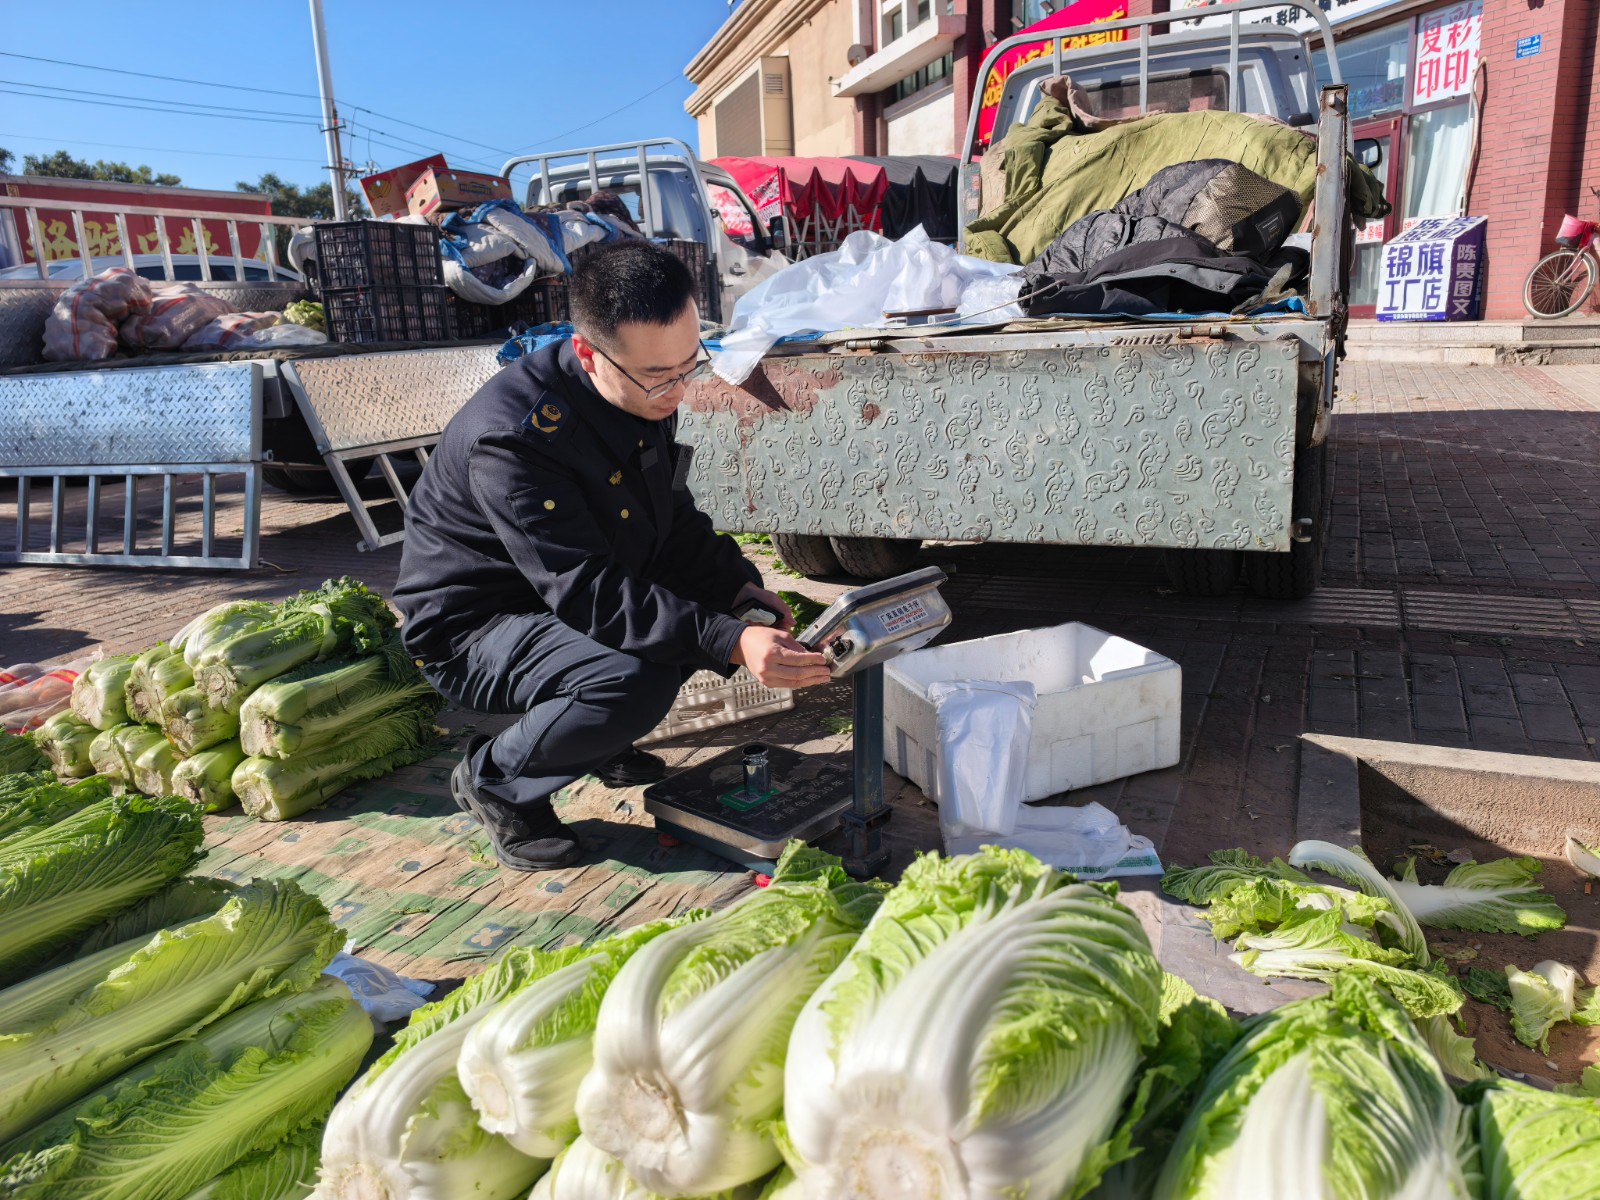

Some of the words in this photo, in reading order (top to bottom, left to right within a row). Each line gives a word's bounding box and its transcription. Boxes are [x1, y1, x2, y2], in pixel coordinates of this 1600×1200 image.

[1276, 6, 1300, 26] 彩印
[1386, 242, 1446, 279] 锦旗
[1383, 277, 1442, 311] 工厂店
[1452, 244, 1477, 315] 陈贵图文
